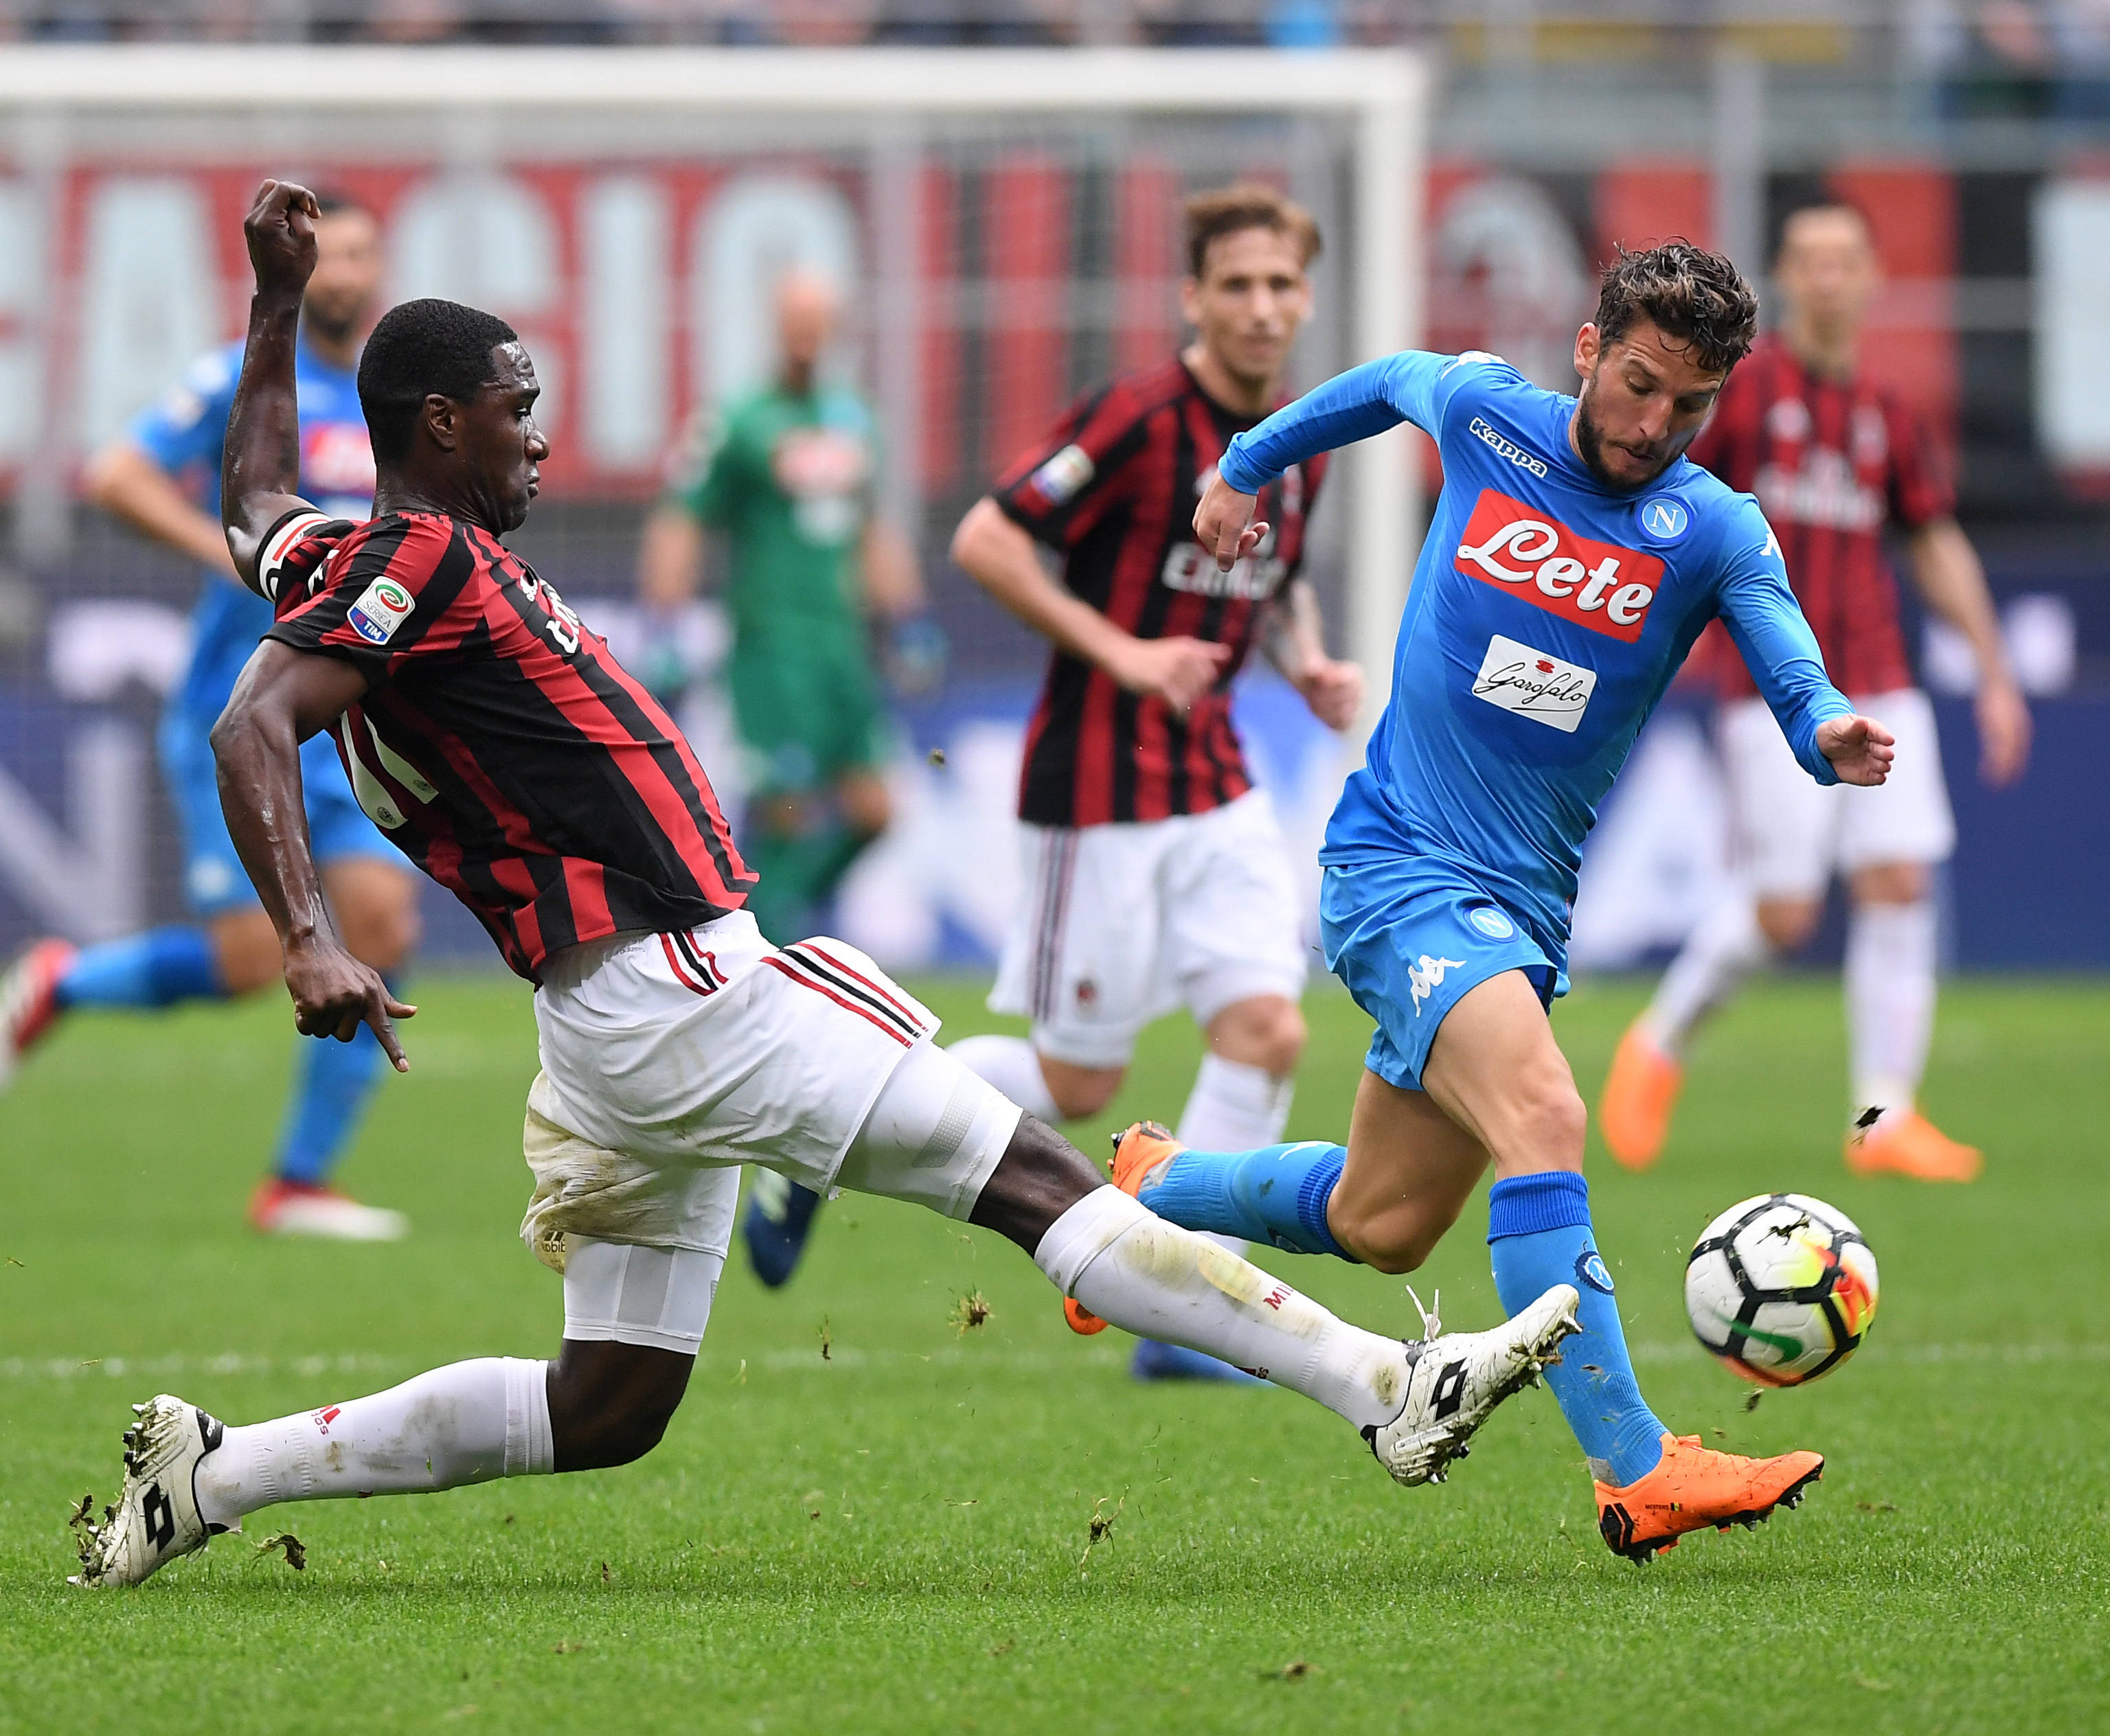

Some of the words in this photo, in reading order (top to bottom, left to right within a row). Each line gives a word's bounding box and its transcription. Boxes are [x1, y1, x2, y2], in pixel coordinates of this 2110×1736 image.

[1469, 417, 1547, 478] Kappa
[1650, 504, 1679, 532] N
[1457, 519, 1653, 625] Lete
[363, 601, 387, 621] SERIE
[364, 620, 382, 640] TIM
[1473, 662, 1587, 711] Garofalo
[1476, 912, 1507, 933] N
